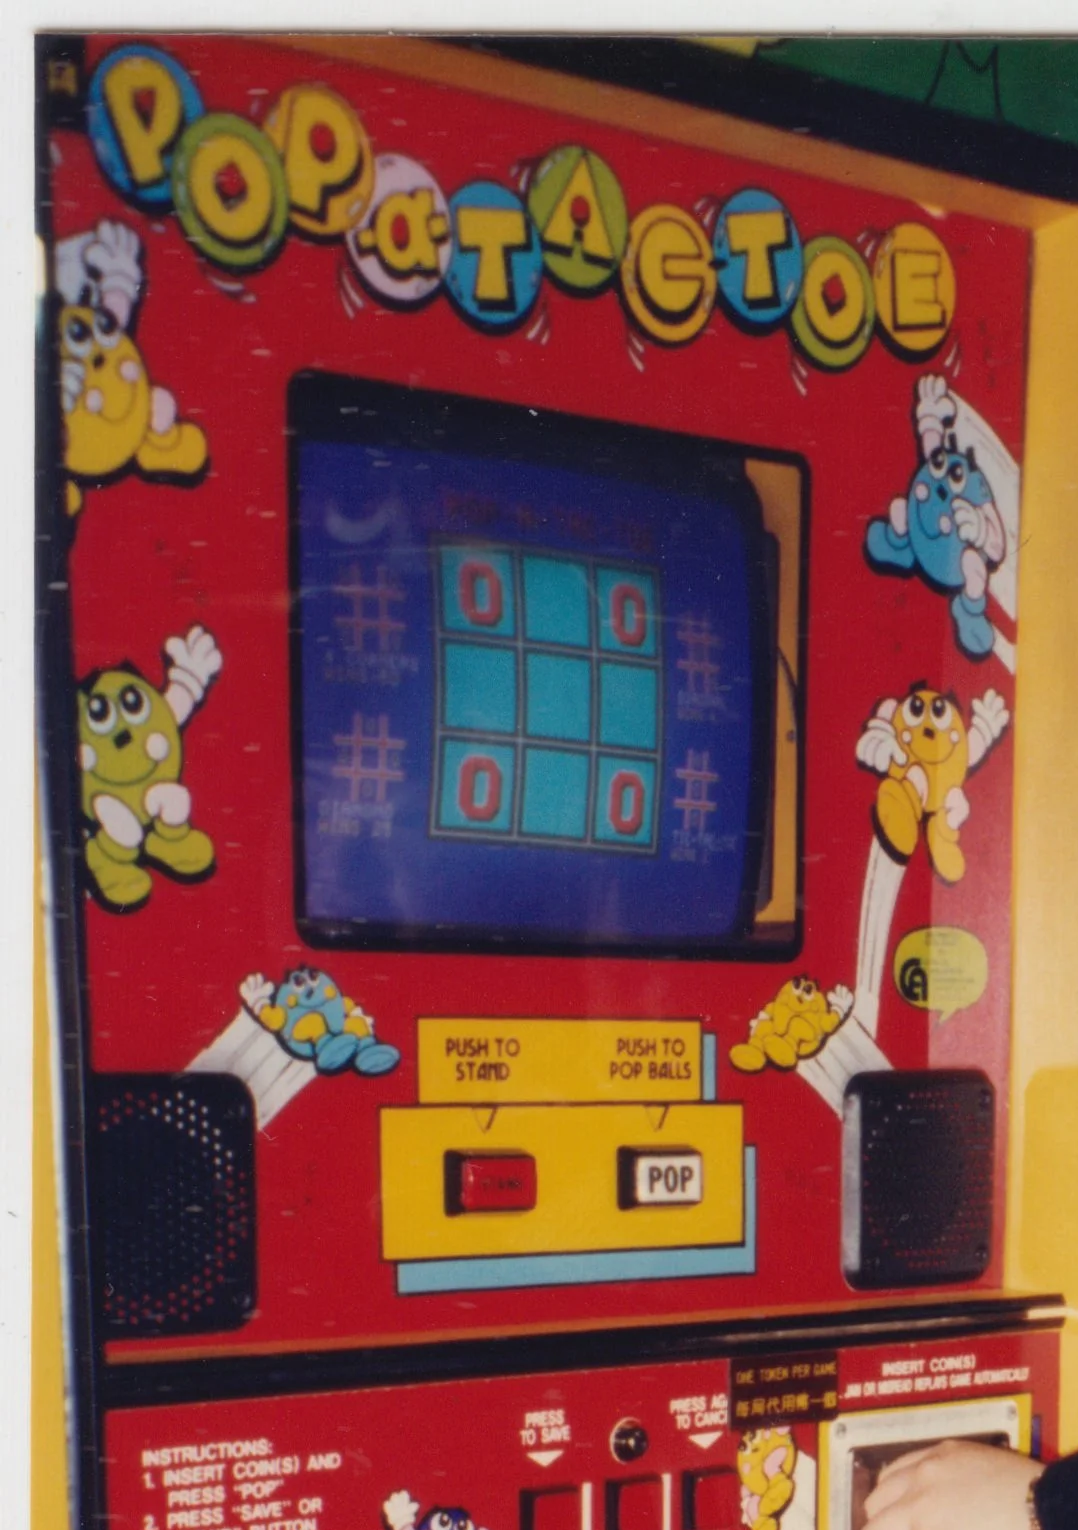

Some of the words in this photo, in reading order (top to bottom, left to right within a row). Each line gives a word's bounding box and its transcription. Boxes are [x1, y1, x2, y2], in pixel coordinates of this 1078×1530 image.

[446, 1038, 489, 1058] PUSH
[494, 1037, 521, 1057] TO
[617, 1038, 658, 1057] PUSH
[662, 1037, 686, 1057] TO
[455, 1060, 511, 1082] STAND
[610, 1060, 645, 1080] POP
[648, 1060, 693, 1081] BALLS
[648, 1165, 694, 1195] POP
[736, 1369, 758, 1386] ONE
[760, 1365, 789, 1383] TOKEN
[791, 1362, 812, 1380] PER
[814, 1360, 837, 1378] GAME
[882, 1359, 925, 1377] INSERT
[929, 1353, 976, 1373] COIN(S)
[669, 1396, 707, 1414] PRESS
[525, 1410, 565, 1430] PRESS
[675, 1413, 691, 1430] TO
[520, 1429, 538, 1448] TO
[541, 1426, 571, 1445] SAVE
[142, 1438, 273, 1467] INSTRUCTIONS:
[144, 1472, 155, 1489] 1.
[164, 1464, 226, 1487] INSERT
[233, 1456, 300, 1480] COIN(S)
[307, 1452, 342, 1471] AND
[167, 1485, 225, 1508] PRESS
[167, 1507, 224, 1530] PRESS
[299, 1498, 323, 1515] OR
